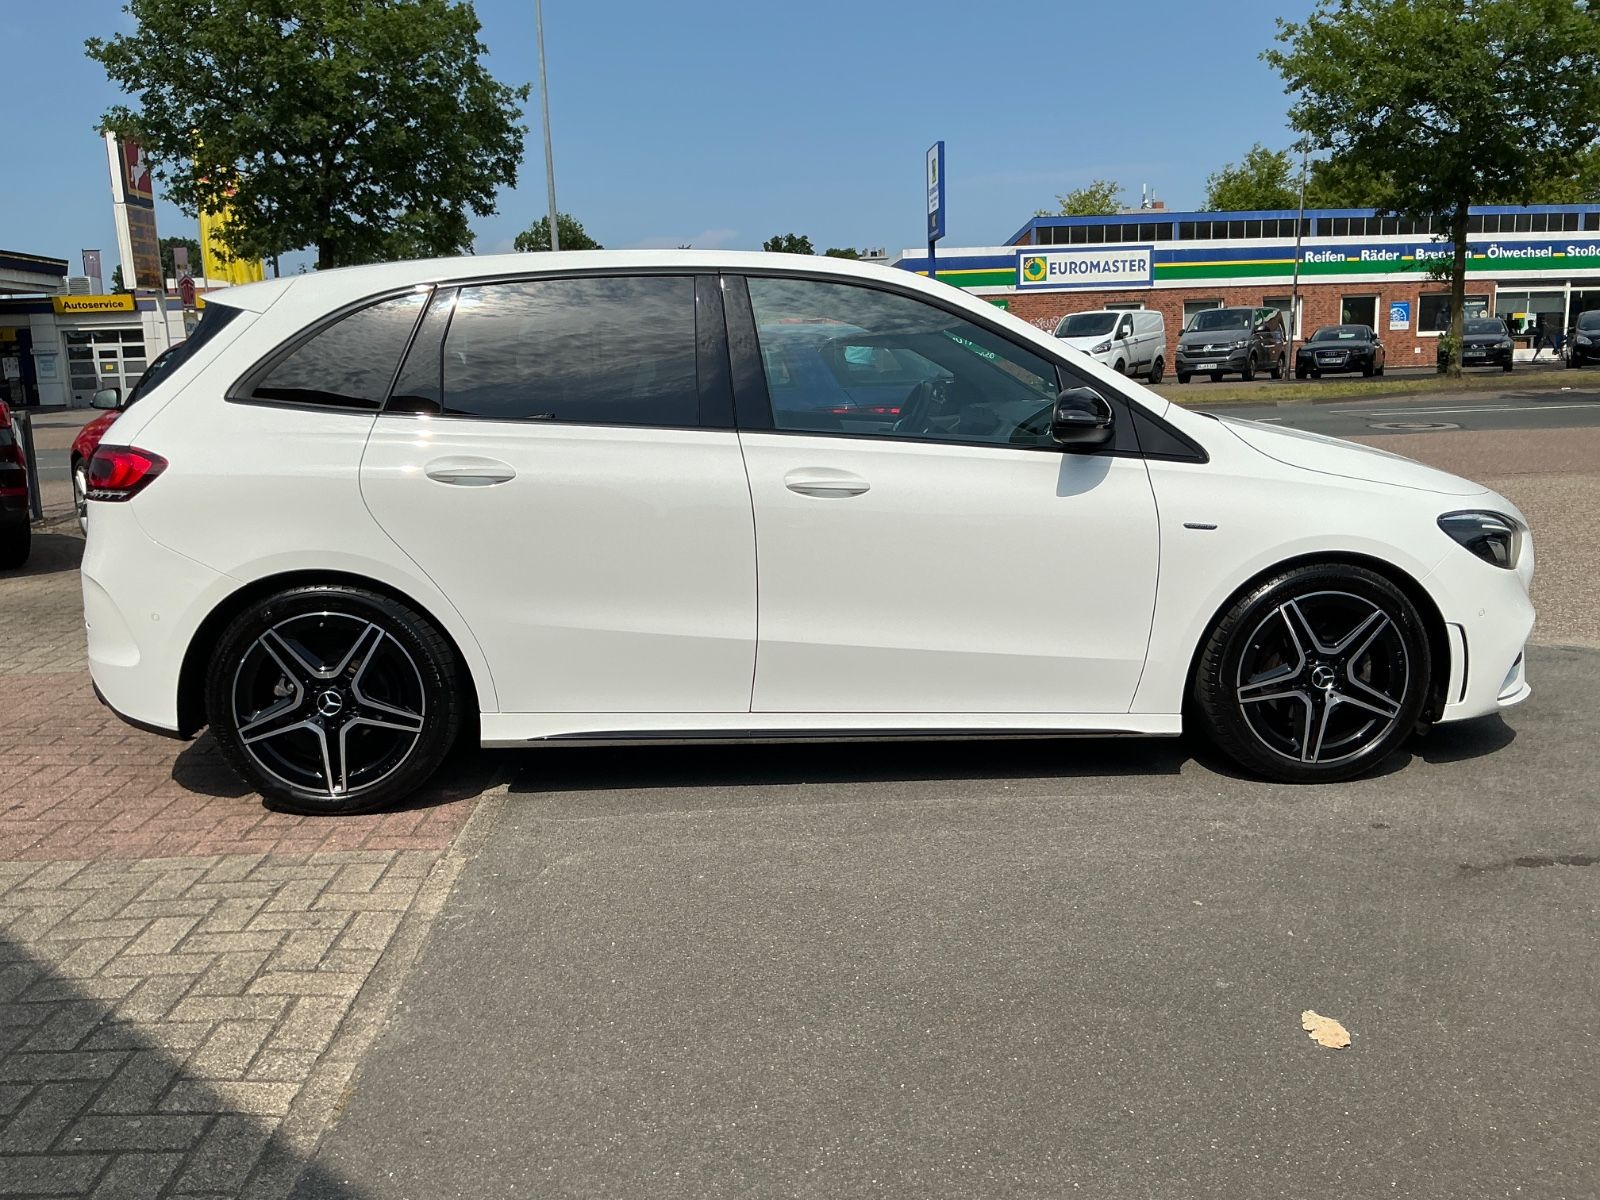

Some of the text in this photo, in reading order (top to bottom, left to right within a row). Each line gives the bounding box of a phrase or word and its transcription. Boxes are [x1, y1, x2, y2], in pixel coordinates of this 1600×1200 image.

[1305, 251, 1345, 263] Reifen
[1361, 249, 1400, 261] Räder
[1487, 243, 1552, 258] Ölwechsel
[1049, 258, 1147, 275] EUROMASTER
[63, 299, 124, 310] Autoservice
